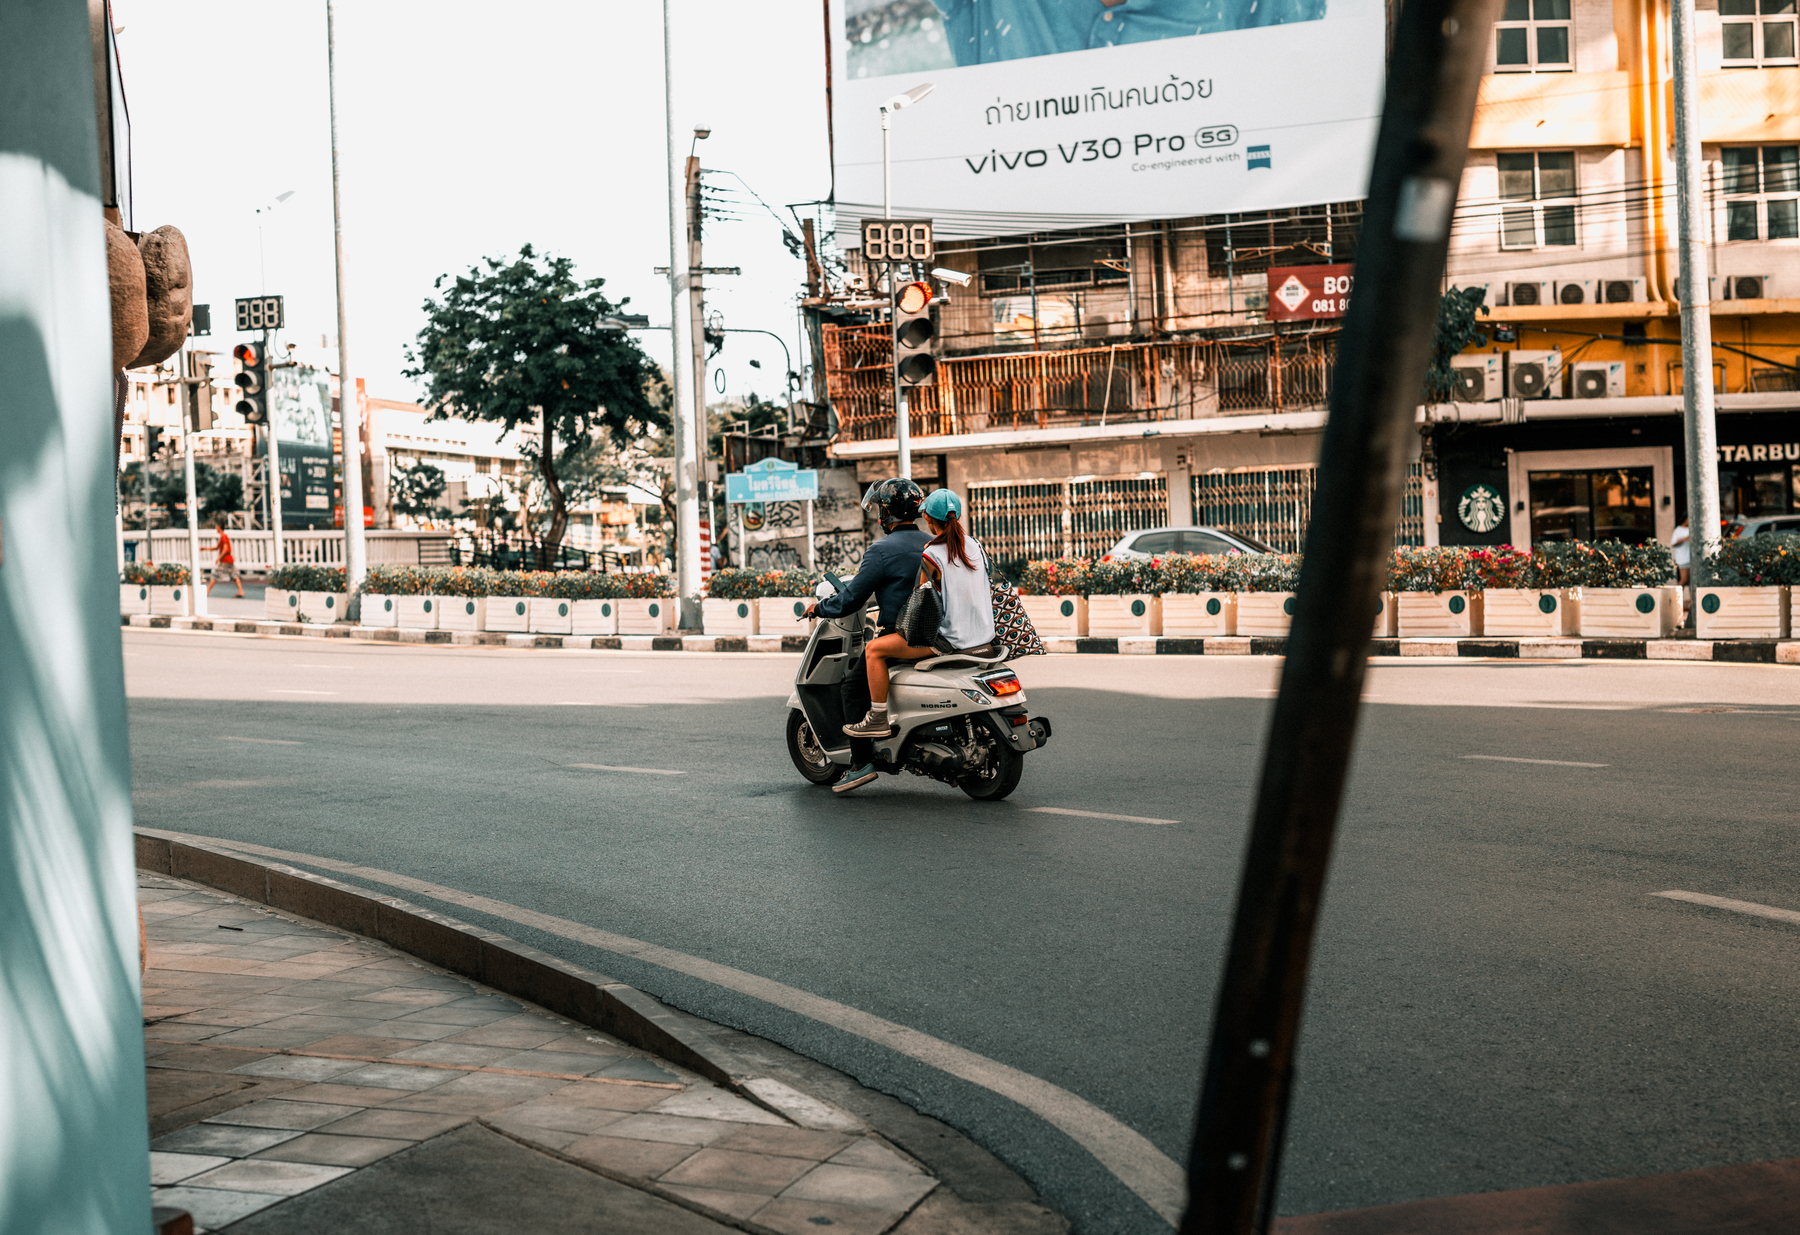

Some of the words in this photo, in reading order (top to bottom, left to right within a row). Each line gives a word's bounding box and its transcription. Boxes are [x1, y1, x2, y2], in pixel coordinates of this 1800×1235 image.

[965, 148, 1048, 174] vivo
[1057, 137, 1122, 163] V30
[1134, 133, 1186, 155] Pro
[1201, 129, 1231, 143] 5G
[1131, 154, 1212, 172] Co-engineered
[1215, 152, 1240, 163] with
[1312, 299, 1336, 313] 081
